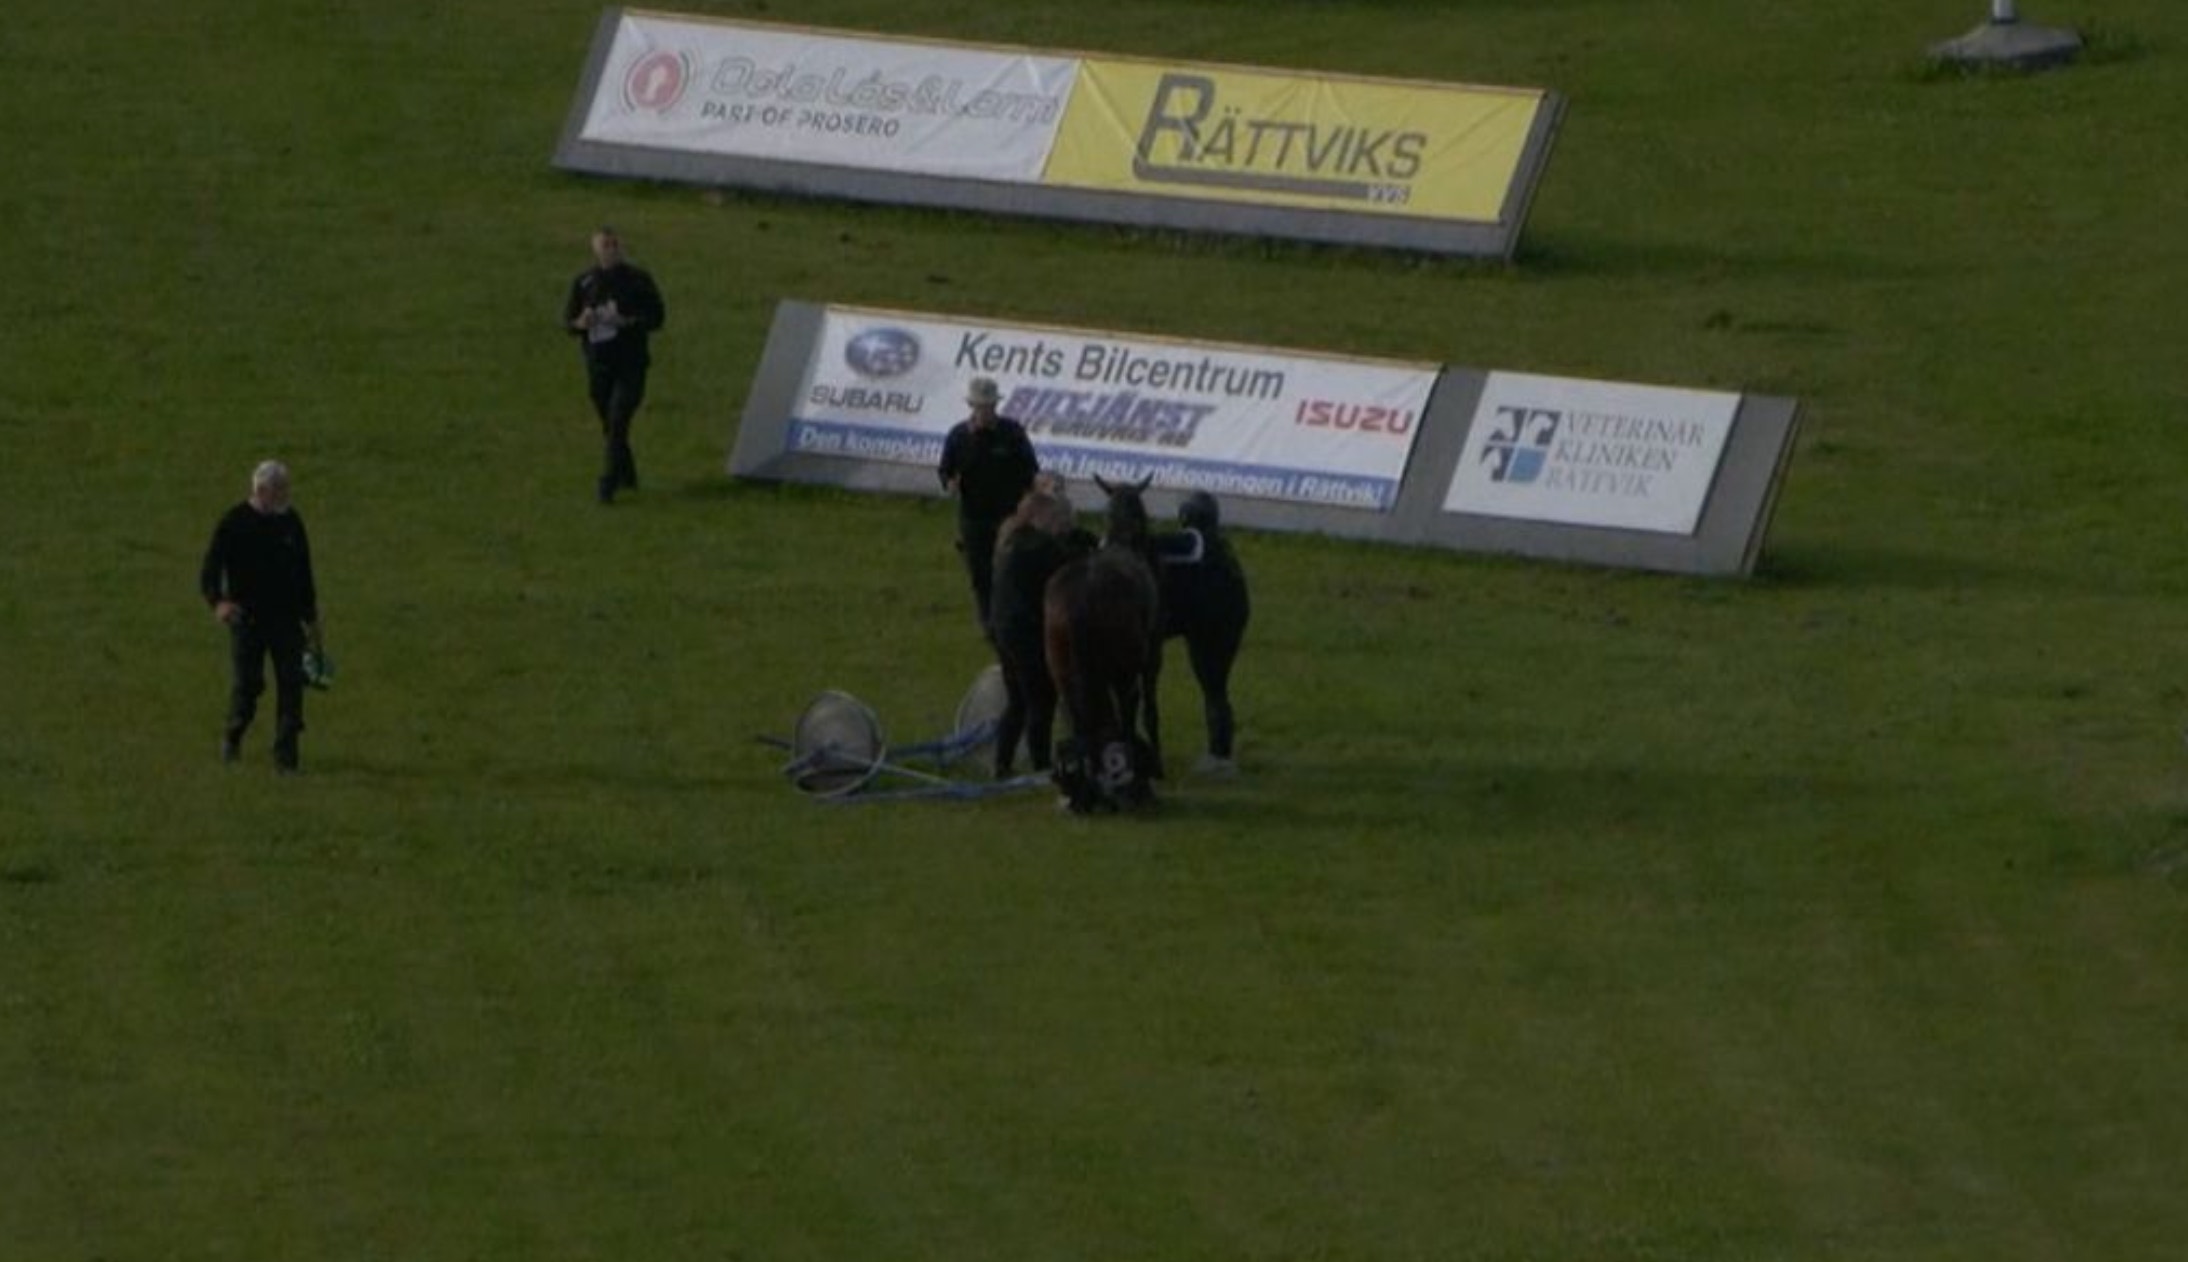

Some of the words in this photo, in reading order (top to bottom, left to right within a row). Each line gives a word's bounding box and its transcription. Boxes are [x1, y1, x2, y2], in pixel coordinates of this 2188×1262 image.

[700, 101, 755, 122] PART
[762, 106, 790, 126] OF
[798, 110, 900, 138] PROSERO
[1133, 74, 1428, 181] RÄTTVIKS
[955, 332, 1063, 377] Kents
[1075, 344, 1285, 399] Bilcentrum
[809, 385, 924, 413] SUBARU
[1295, 400, 1413, 435] ISUZU
[799, 425, 841, 449] Den
[844, 429, 943, 461] komplett
[1555, 439, 1678, 471] KLINIKEN
